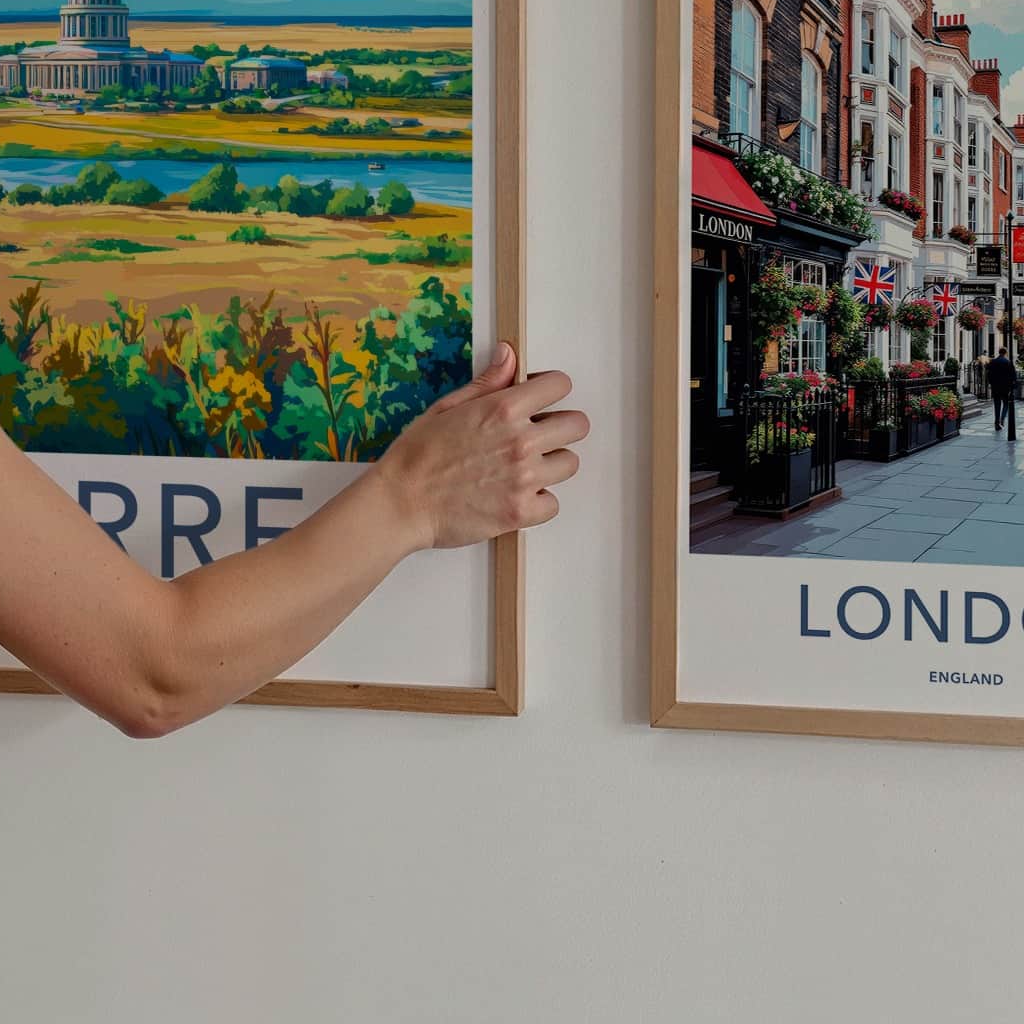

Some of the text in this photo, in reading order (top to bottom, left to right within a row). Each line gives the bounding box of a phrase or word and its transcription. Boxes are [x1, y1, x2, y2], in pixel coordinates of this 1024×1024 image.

[698, 213, 753, 242] LONDON
[800, 584, 1024, 644] LOND
[929, 671, 1004, 686] ENGLAND
